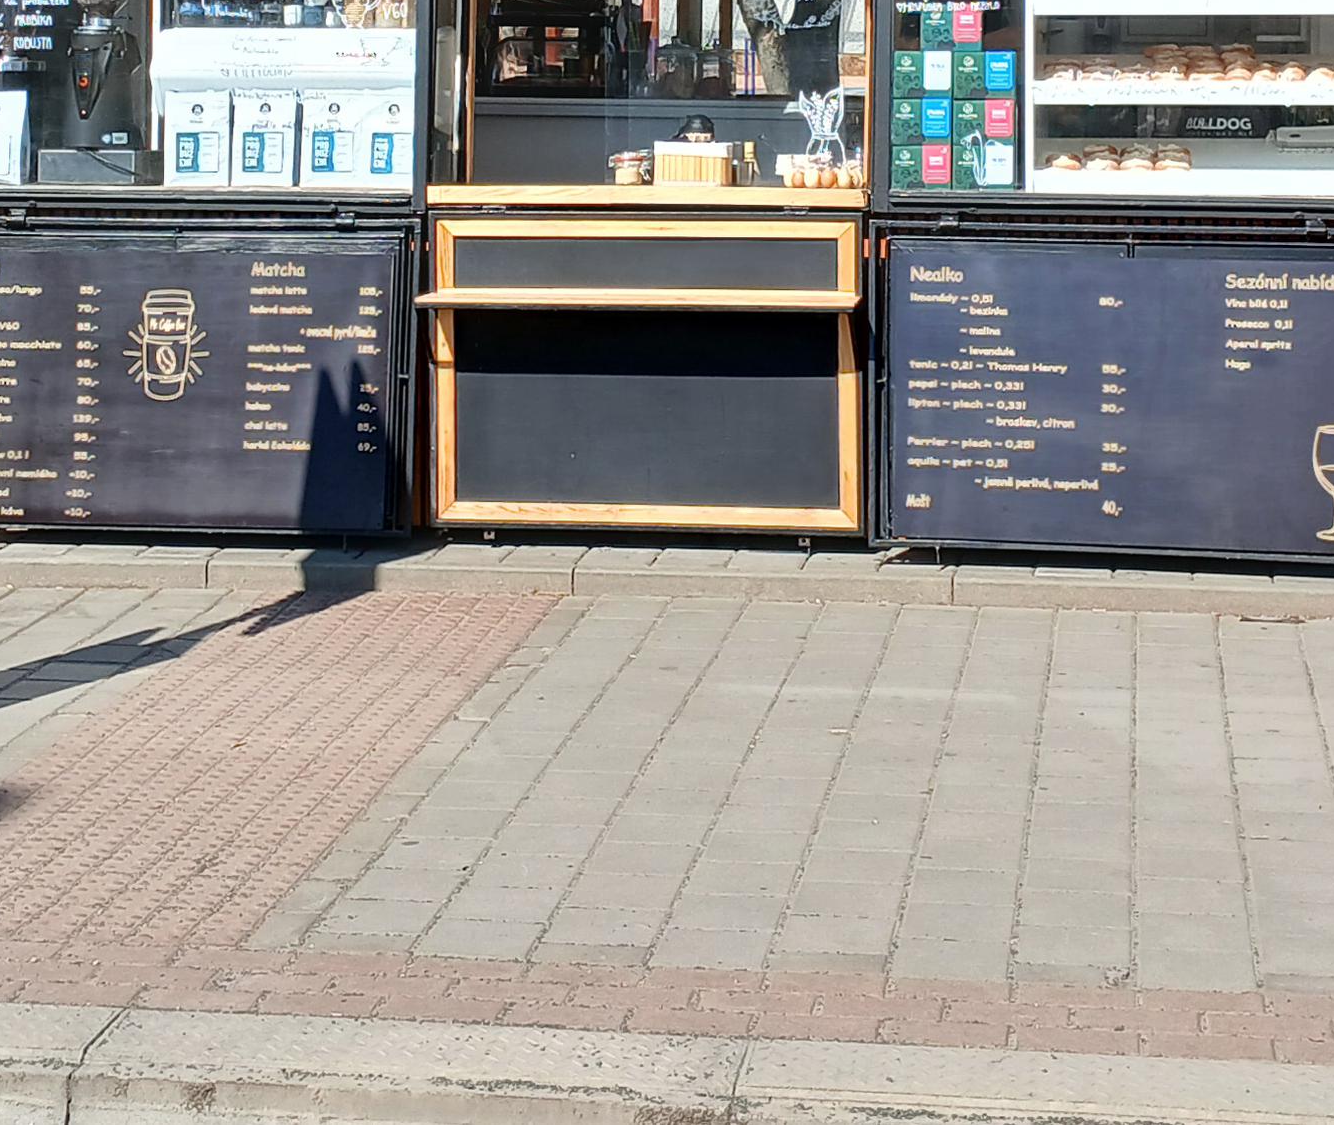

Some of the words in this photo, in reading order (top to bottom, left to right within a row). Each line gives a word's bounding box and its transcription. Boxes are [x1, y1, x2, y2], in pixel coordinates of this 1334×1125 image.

[13, 36, 53, 51] ROBUSTA
[251, 261, 306, 277] Matcha
[910, 266, 964, 283] Nealko
[1225, 273, 1288, 290] Sezónní
[250, 285, 283, 295] matcha
[285, 286, 307, 295] latte
[910, 292, 959, 304] limonády
[77, 304, 100, 314] 70,-
[279, 305, 313, 315] matcha
[969, 306, 1008, 316] bezinka
[159, 317, 175, 332] Coffee
[1225, 318, 1269, 329] Prosecco
[969, 327, 1001, 336] malina
[10, 340, 62, 350] macchiato
[76, 341, 99, 351] 60,-
[247, 343, 281, 353] matcha
[282, 344, 306, 353] tonic
[1225, 339, 1259, 350] Aperol
[1260, 340, 1292, 351] spritz
[969, 346, 1016, 356] levandule
[909, 360, 938, 370] tonic
[987, 361, 1030, 372] Thomas
[1032, 363, 1068, 374] Henry
[1225, 359, 1251, 371] Hugo
[76, 377, 99, 387] 70,-
[1102, 384, 1127, 395] 30,-
[357, 403, 377, 413] 40,-
[908, 398, 941, 410] lipton
[1101, 403, 1125, 414] 30,-
[265, 421, 288, 431] latte
[1043, 418, 1075, 429] citron
[357, 442, 377, 452] 69,-
[907, 437, 949, 447] Perrier
[1102, 443, 1127, 453] 35,-
[953, 459, 972, 469] pet
[906, 494, 931, 509] Mošt
[1102, 500, 1123, 517] 40,-
[1, 507, 24, 516] káva
